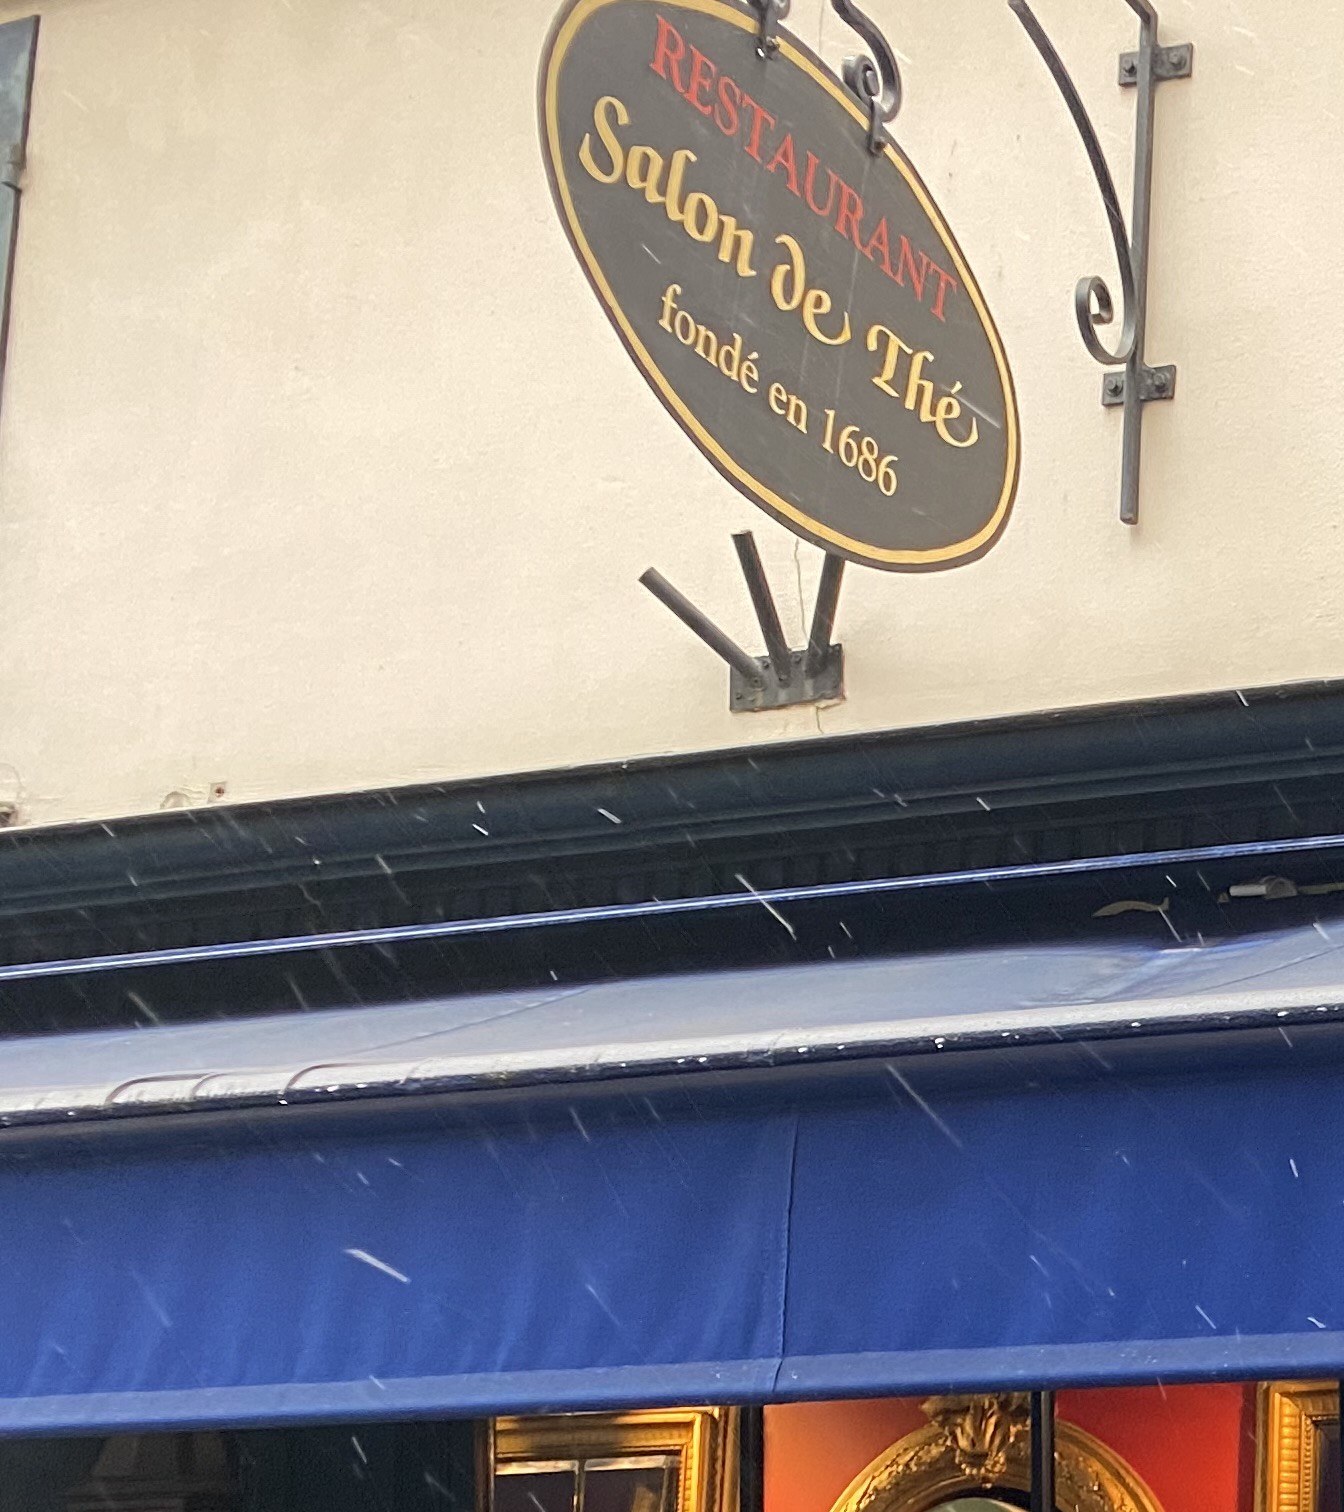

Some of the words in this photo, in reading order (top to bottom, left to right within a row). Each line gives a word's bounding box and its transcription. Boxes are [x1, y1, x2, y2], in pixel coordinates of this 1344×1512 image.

[578, 95, 757, 278] Salon
[771, 234, 851, 346] de
[866, 325, 979, 448] Thé
[648, 14, 957, 322] RESTAURANT
[658, 283, 760, 394] fondé
[768, 381, 808, 434] en
[823, 408, 899, 497] 1686
